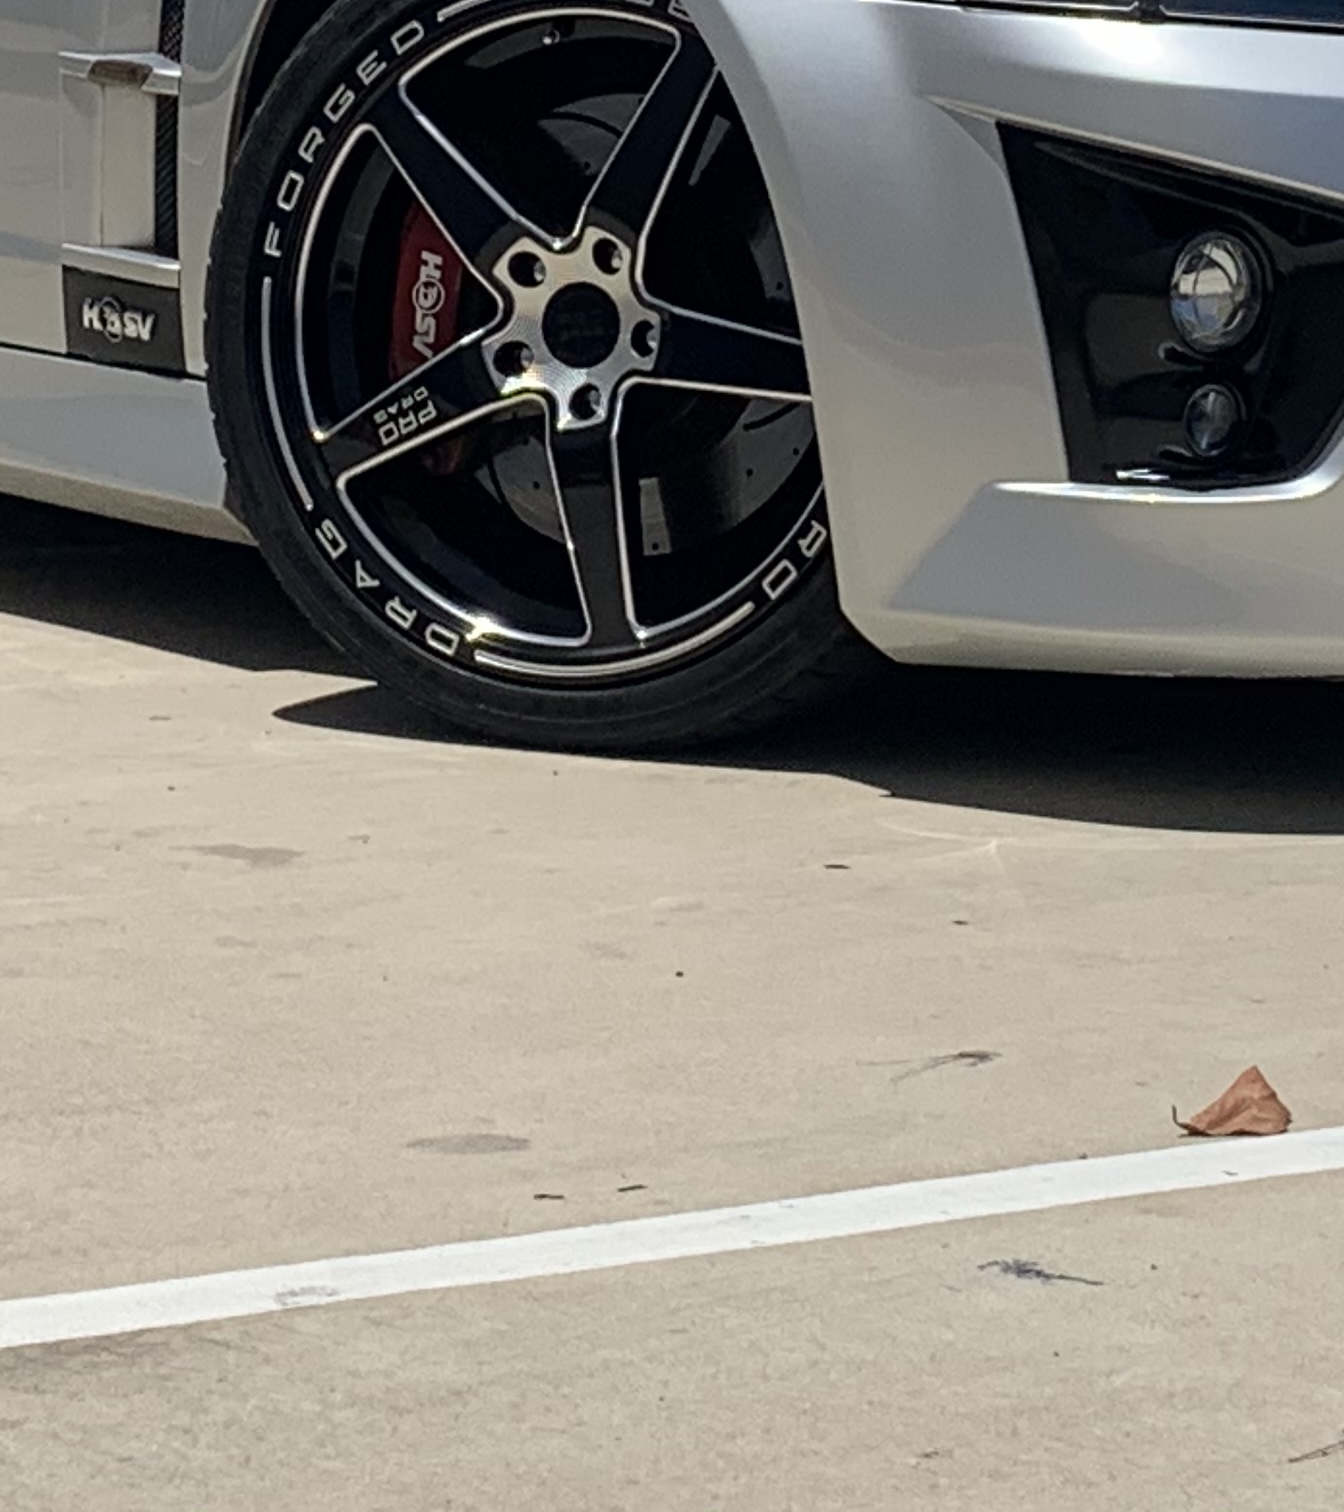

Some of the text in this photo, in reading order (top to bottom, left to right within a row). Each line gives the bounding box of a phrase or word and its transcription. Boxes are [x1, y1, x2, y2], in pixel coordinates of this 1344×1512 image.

[263, 19, 426, 259] FORGED
[378, 399, 438, 446] PRO
[312, 518, 464, 656] DRAG
